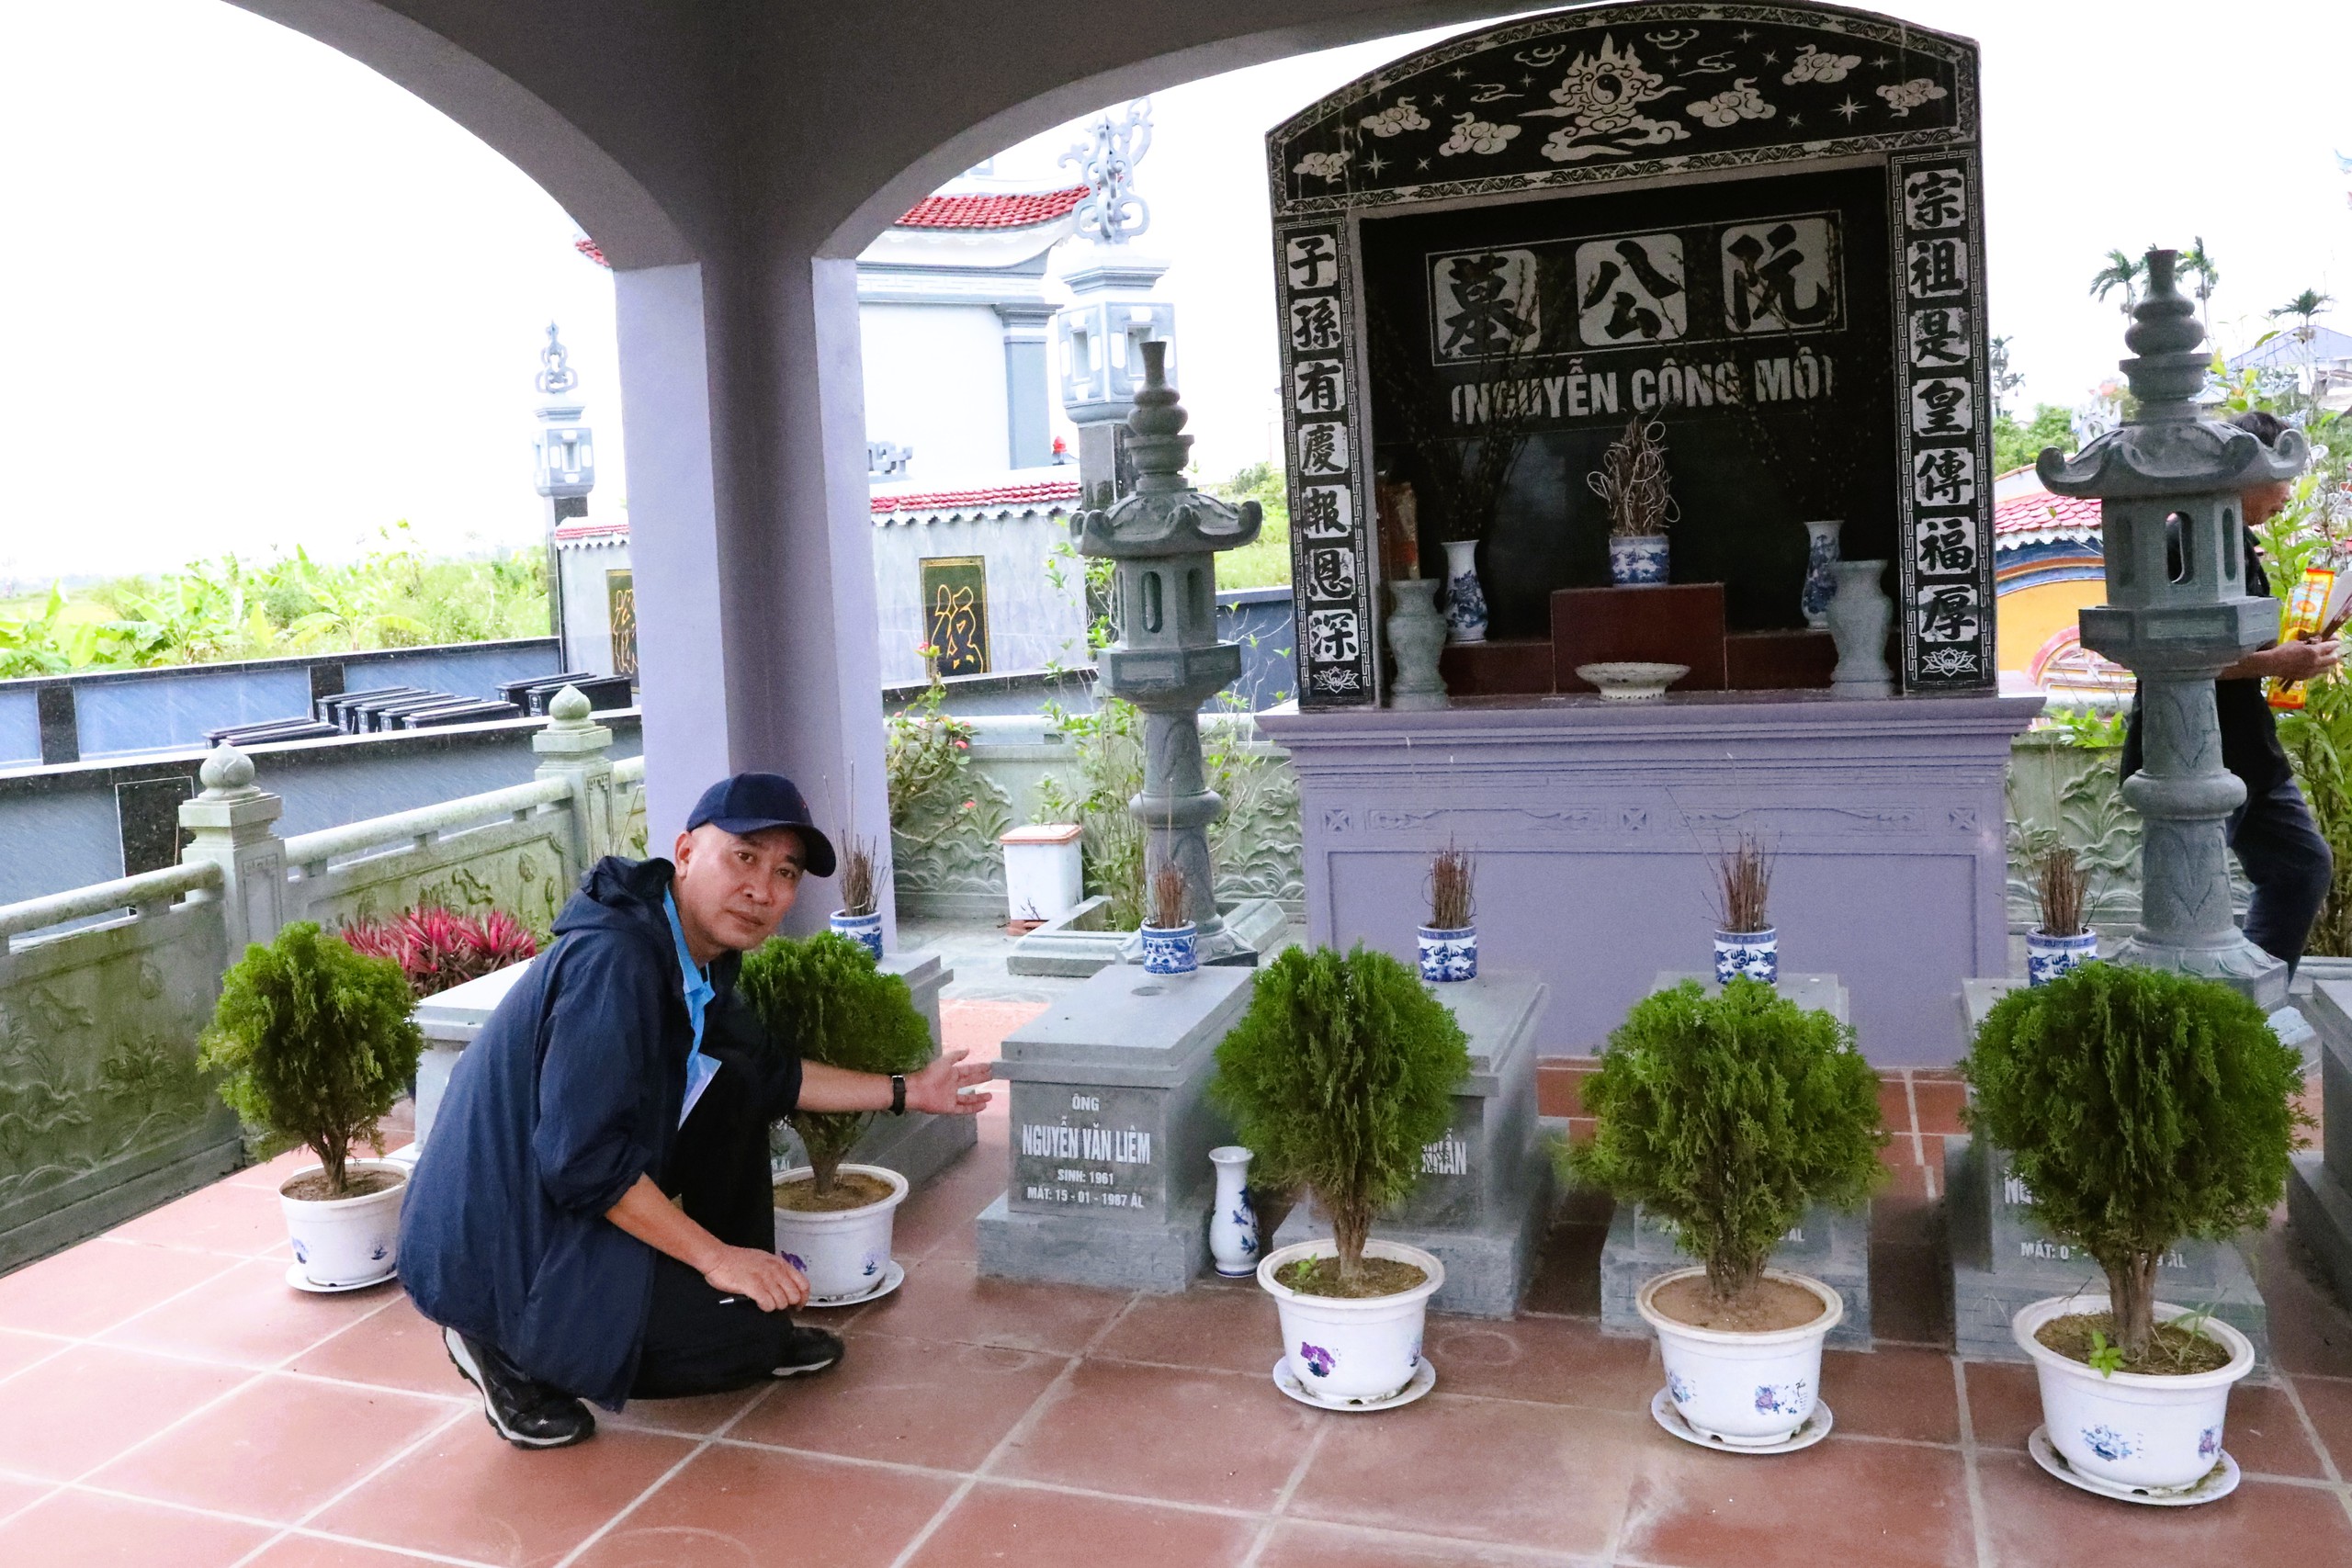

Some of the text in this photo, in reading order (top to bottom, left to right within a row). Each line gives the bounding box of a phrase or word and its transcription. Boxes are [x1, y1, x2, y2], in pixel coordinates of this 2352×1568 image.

[1071, 1092, 1100, 1111] ÔNG
[1022, 1115, 1150, 1165] NGUYỄN VĂN LIÊM
[1057, 1168, 1114, 1185] SINH: 1961
[1055, 1189, 1068, 1201] 15
[1078, 1190, 1090, 1203] 01
